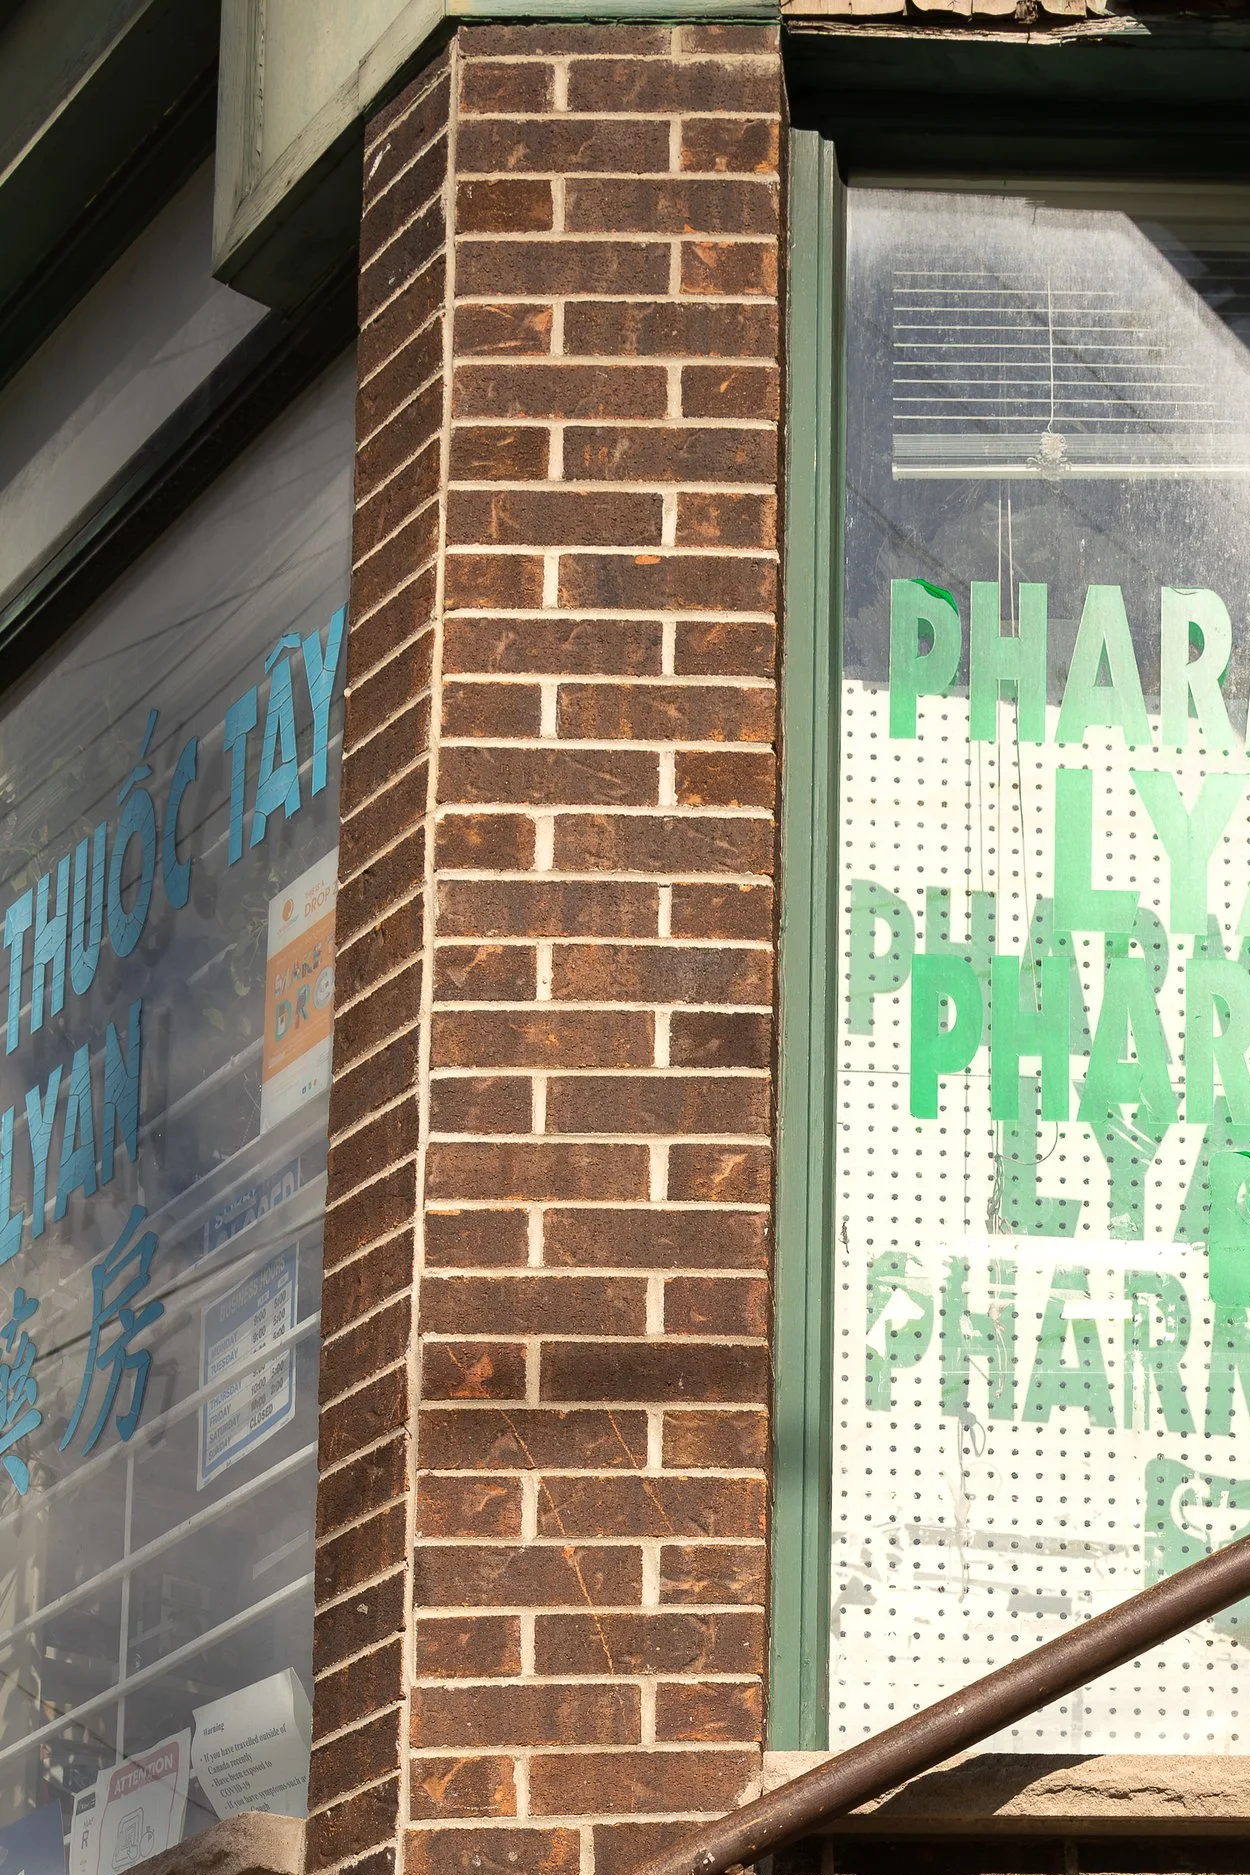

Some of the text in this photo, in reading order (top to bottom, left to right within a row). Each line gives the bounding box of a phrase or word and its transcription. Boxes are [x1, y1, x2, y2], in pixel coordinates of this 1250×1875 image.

[3, 603, 348, 1056] THUỐC TÂY
[304, 887, 332, 918] DROP
[0, 999, 142, 1266] LYAN
[219, 1278, 258, 1322] BUSINESS
[259, 1254, 285, 1291] HOURS
[211, 1347, 239, 1376] TUESDAY
[209, 1403, 232, 1428] FRIDAY
[209, 1413, 240, 1445] SATURDAY
[249, 1403, 273, 1429] CLOSED
[234, 1734, 259, 1751] travelled
[259, 1727, 280, 1742] outside
[114, 1754, 174, 1798] ATTENTION
[207, 1752, 252, 1775] Canada recently
[243, 1761, 265, 1777] exposed
[220, 1780, 251, 1798] COVID-19
[258, 1783, 288, 1800] symptoms
